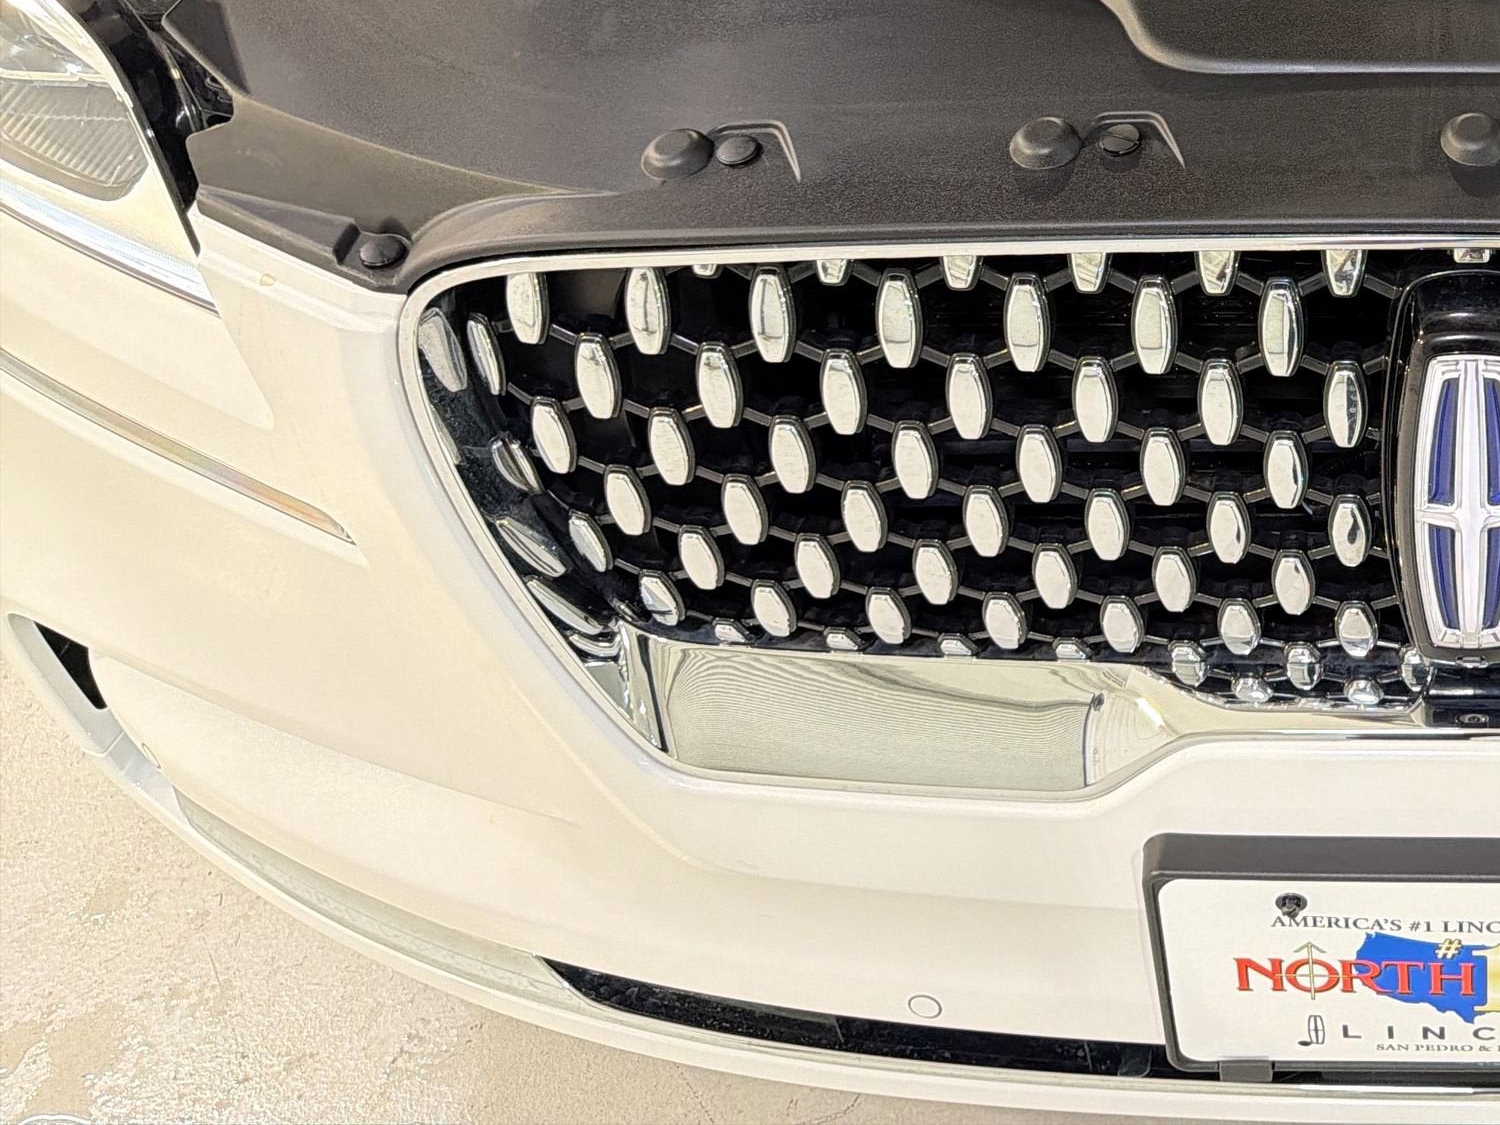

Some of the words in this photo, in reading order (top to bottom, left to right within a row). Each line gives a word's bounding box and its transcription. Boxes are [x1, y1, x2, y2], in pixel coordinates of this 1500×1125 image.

[1271, 915, 1402, 932] AMERICA'S
[1409, 920, 1434, 933] #1
[1233, 958, 1476, 996] NORTH
[1376, 1043, 1410, 1052] SAN
[1415, 1044, 1474, 1052] PEDRO
[1478, 1044, 1493, 1053] &
